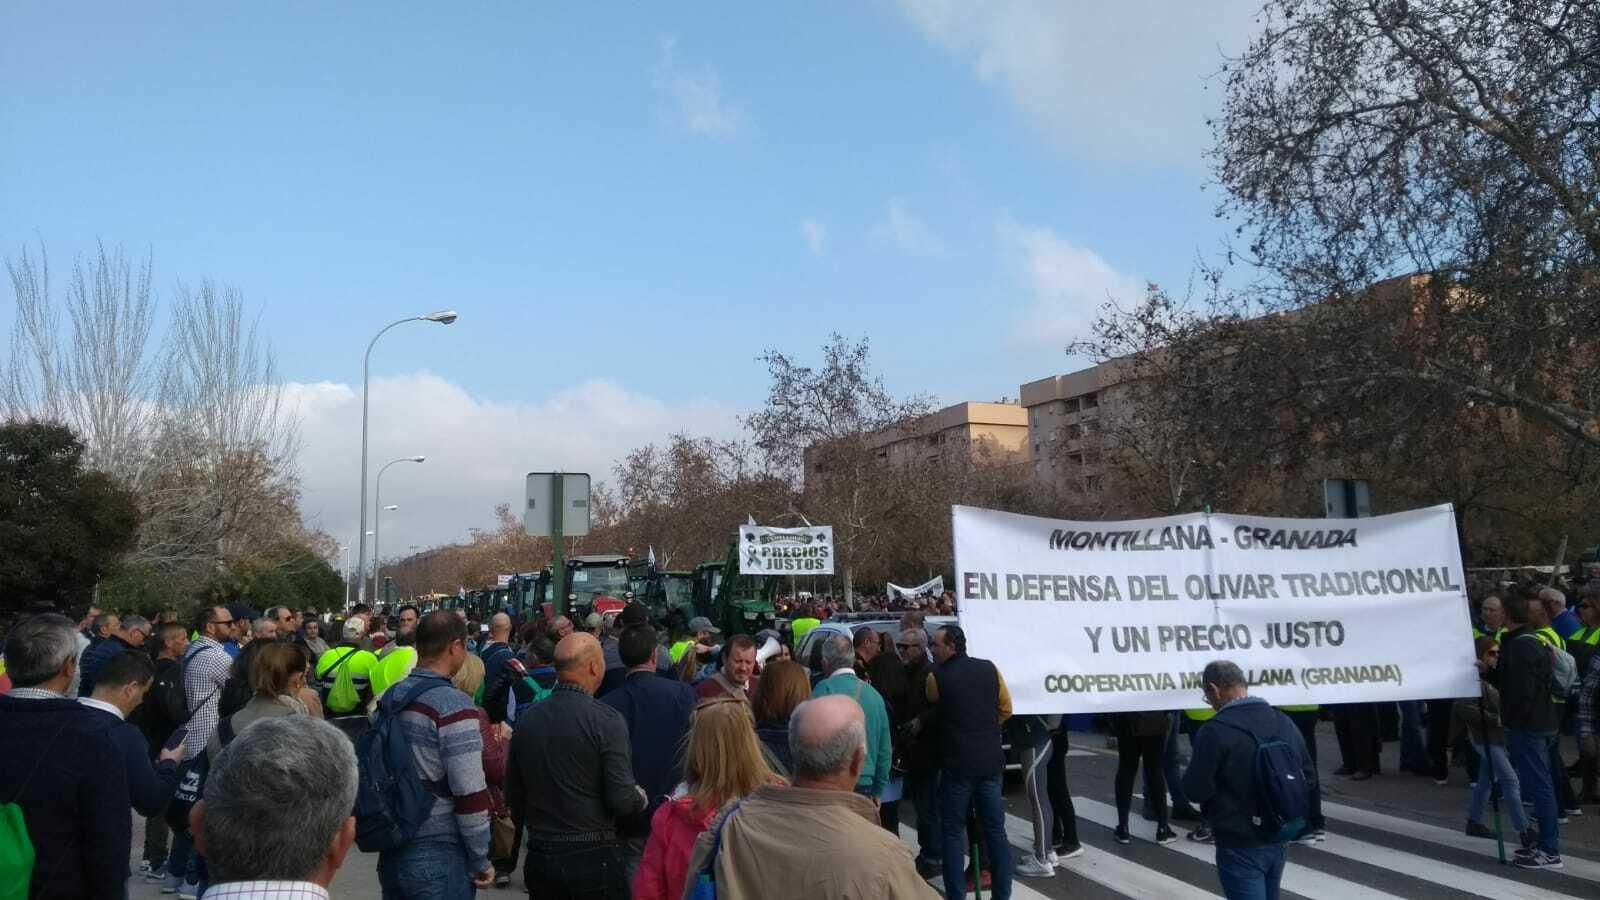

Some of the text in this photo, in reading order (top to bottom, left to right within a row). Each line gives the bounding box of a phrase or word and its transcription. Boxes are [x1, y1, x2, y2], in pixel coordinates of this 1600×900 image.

[1049, 525, 1215, 551] MONTILLANA
[1233, 525, 1358, 550] GRANADA
[761, 546, 829, 558] PRECIOS
[766, 558, 825, 570] JUSTOS
[963, 572, 998, 600] EN
[1005, 573, 1122, 602] DEFENSA
[1127, 575, 1178, 601] DEL
[1184, 573, 1279, 601] OLIVAR
[1281, 566, 1460, 598] TRADICIONAL
[1084, 620, 1345, 653] Y UN PRECIO JUSTO
[1044, 672, 1176, 693] COOPERATIVA
[1301, 664, 1402, 689] (GRANADA)
